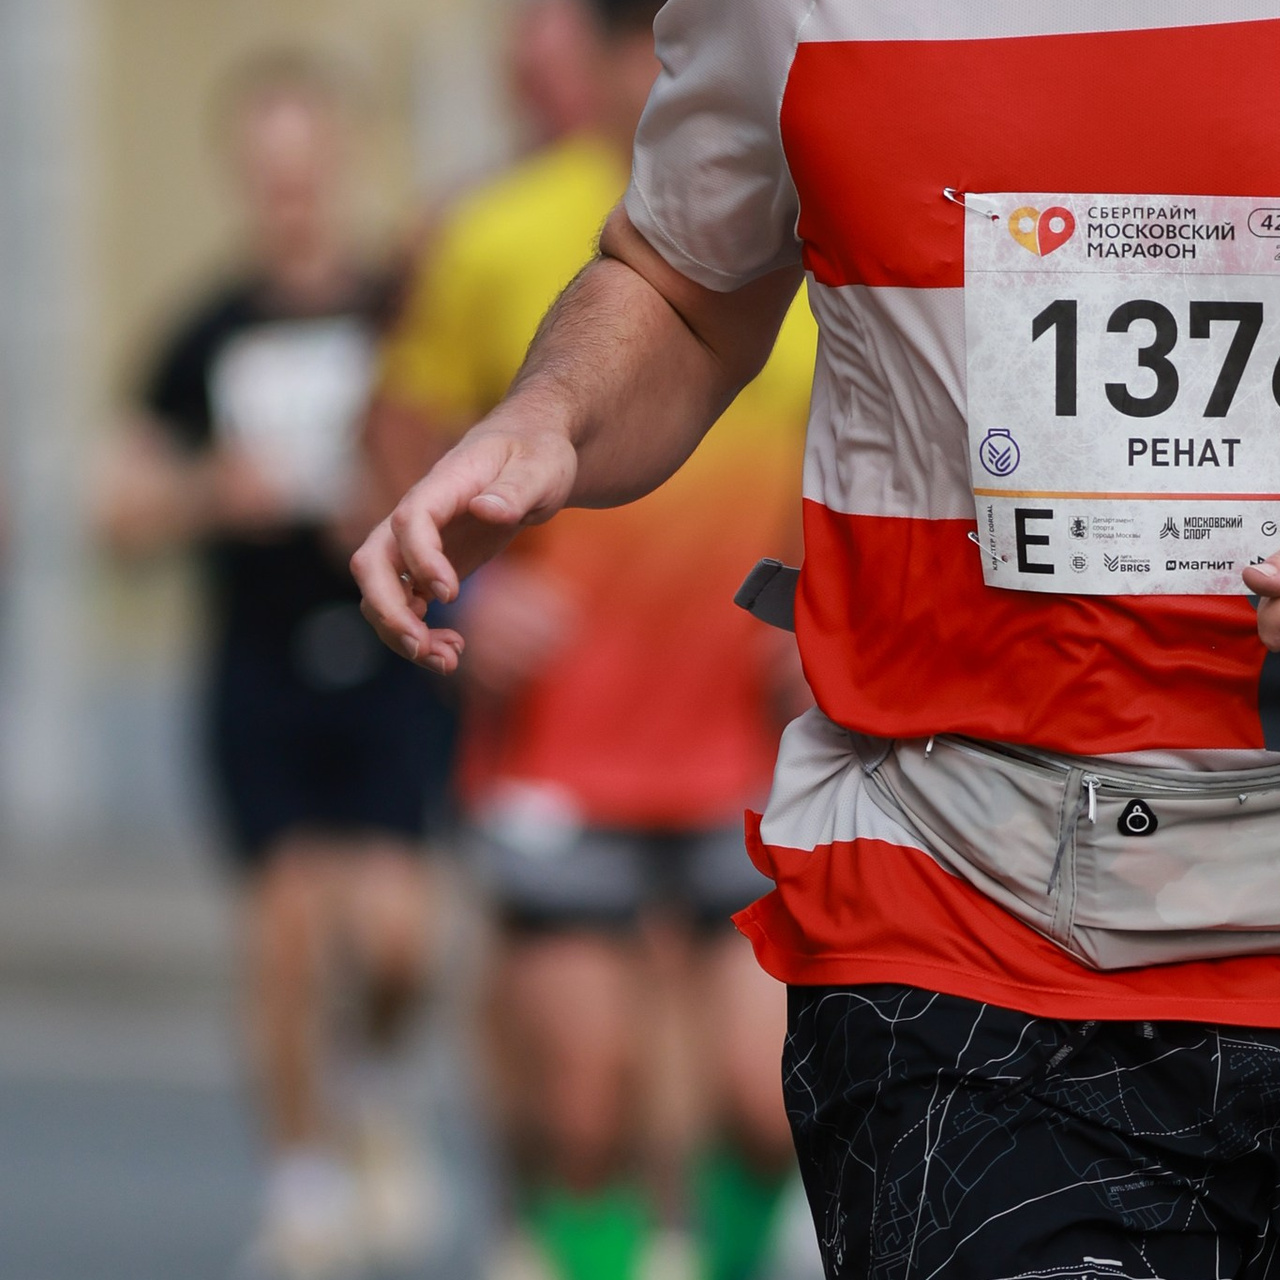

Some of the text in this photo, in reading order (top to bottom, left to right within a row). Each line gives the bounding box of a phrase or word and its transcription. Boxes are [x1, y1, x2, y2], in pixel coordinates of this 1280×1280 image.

[1087, 205, 1196, 220] СБЕРПРАЙМ
[1087, 222, 1236, 241] МОСКОВСКИЙ
[1087, 242, 1196, 259] МАРАФОН
[1128, 438, 1241, 467] РЕНАТ
[1184, 515, 1243, 529] МОСКОВСКИЙ
[1014, 508, 1055, 574] E
[1184, 529, 1211, 540] СПОРТ
[1120, 564, 1151, 572] BRICS
